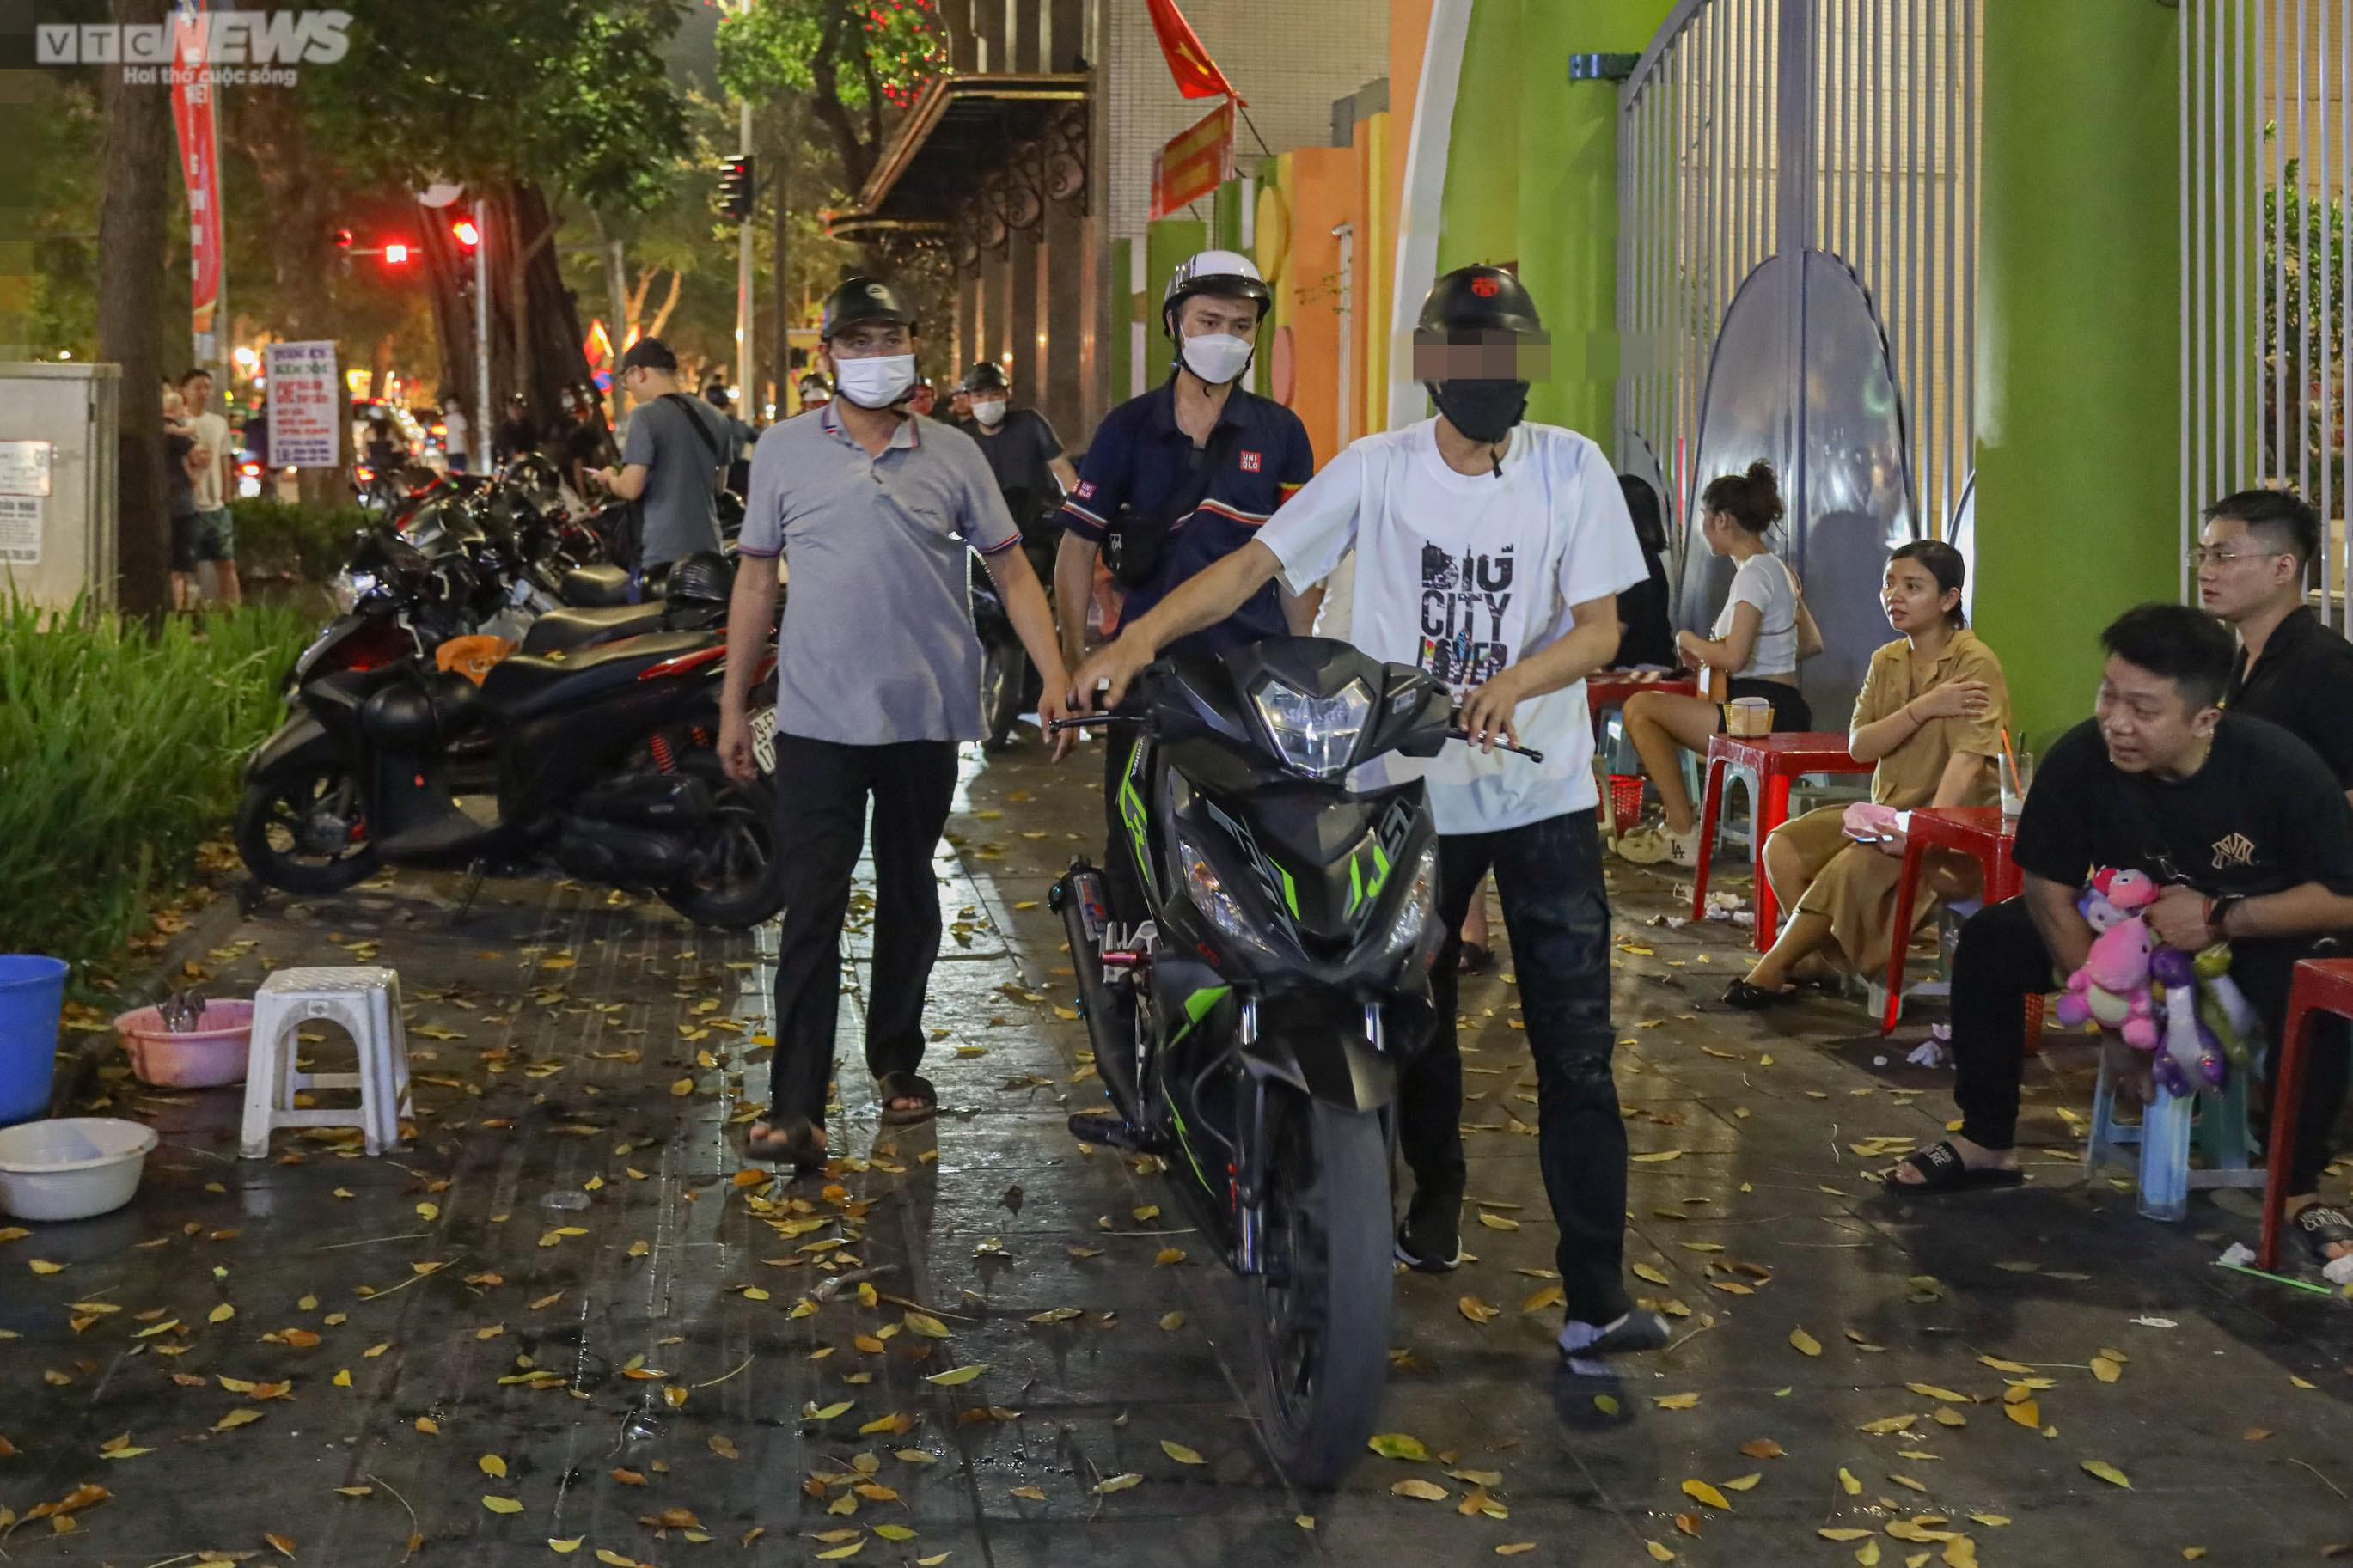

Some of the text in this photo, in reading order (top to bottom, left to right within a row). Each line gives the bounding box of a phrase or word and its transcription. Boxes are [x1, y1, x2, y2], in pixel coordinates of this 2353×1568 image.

[1243, 453, 1257, 462] UNI
[1243, 461, 1258, 470] QLO
[1421, 540, 1513, 593] BIG
[1421, 589, 1512, 643] CITY
[1671, 839, 1685, 859] LA
